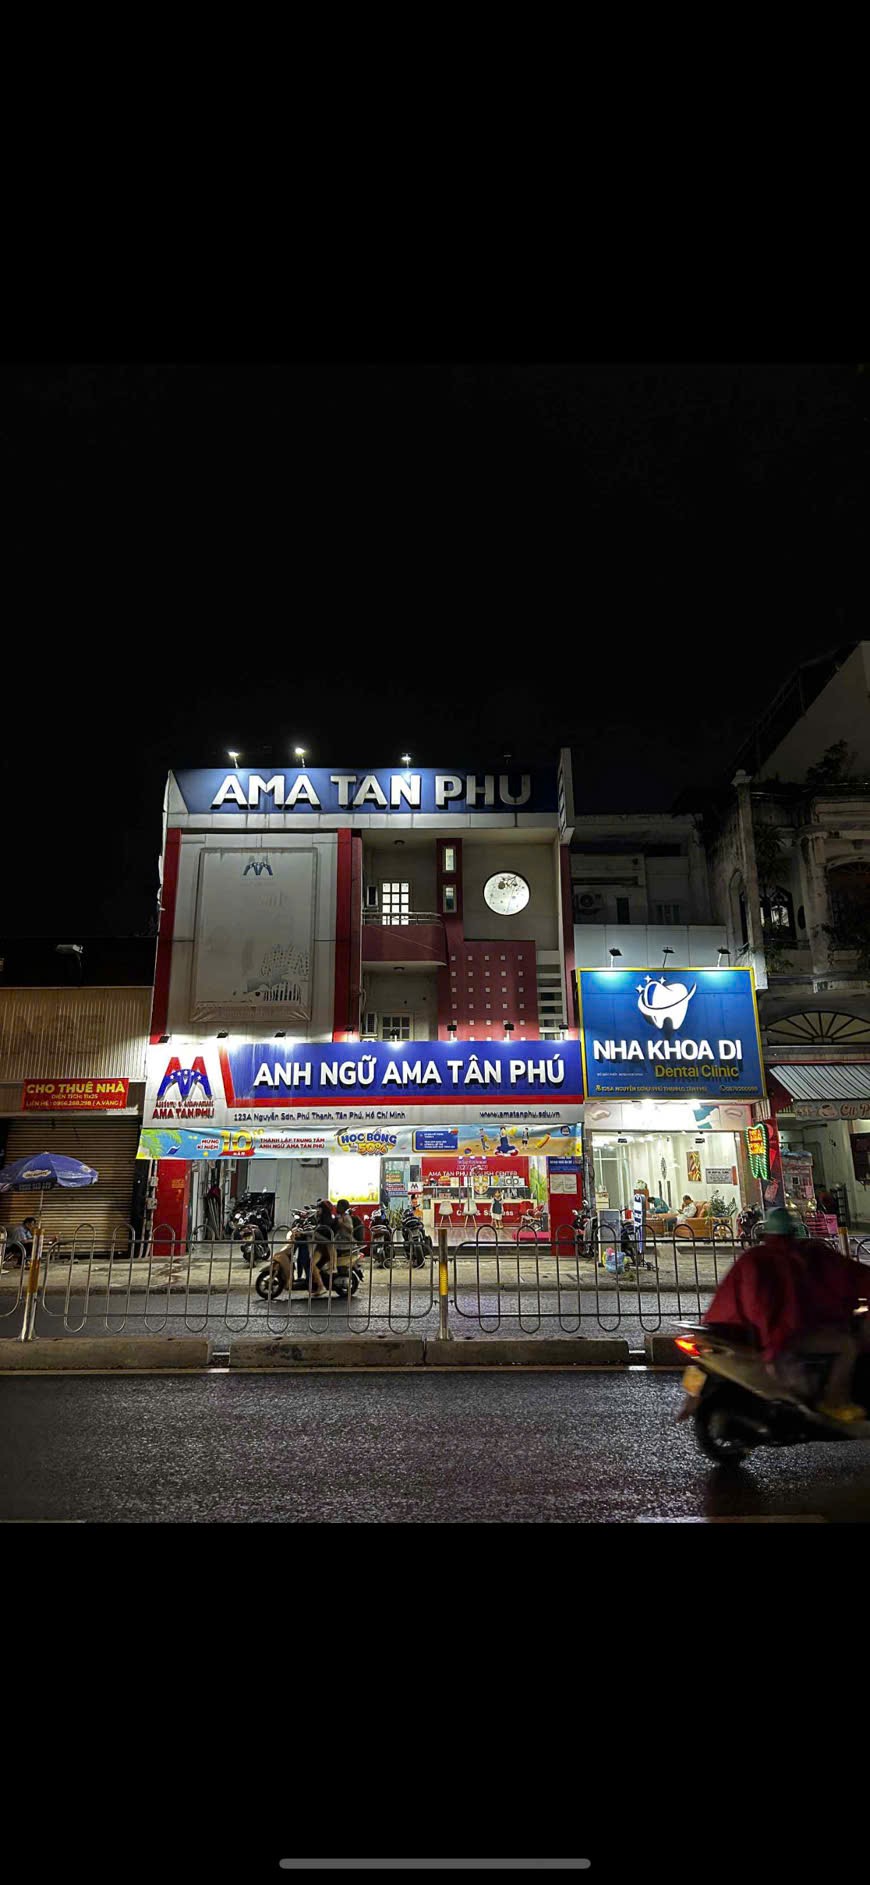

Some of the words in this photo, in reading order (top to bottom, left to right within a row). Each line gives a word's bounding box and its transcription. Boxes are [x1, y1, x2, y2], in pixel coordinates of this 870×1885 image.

[211, 775, 321, 808] AMA
[330, 775, 421, 808] TAN
[435, 775, 531, 807] PHU
[593, 1040, 644, 1061] NHA
[648, 1040, 714, 1060] KHOA
[719, 1040, 743, 1060] DI
[253, 1063, 311, 1086] ANH
[321, 1056, 377, 1086] NGỮ
[382, 1061, 442, 1085] AMA
[447, 1055, 501, 1084] TÂN
[510, 1054, 565, 1084] PHÚ
[655, 1065, 699, 1078] Dental
[701, 1065, 739, 1078] Clinic
[26, 1084, 55, 1094] CHO
[58, 1081, 93, 1093] THUÊ
[96, 1081, 125, 1093] NHÀ
[152, 1108, 174, 1119] AMA
[176, 1108, 194, 1119] TAN
[195, 1108, 214, 1119] PHU
[234, 1113, 252, 1121] 123A
[297, 1112, 310, 1120] Phú
[336, 1112, 348, 1120] Tân
[376, 1111, 389, 1119] Chí
[389, 1111, 406, 1119] Minh
[480, 1110, 560, 1120] www.amatanphu.edu.vn
[221, 1130, 252, 1151] 10
[358, 1142, 388, 1155] 50%
